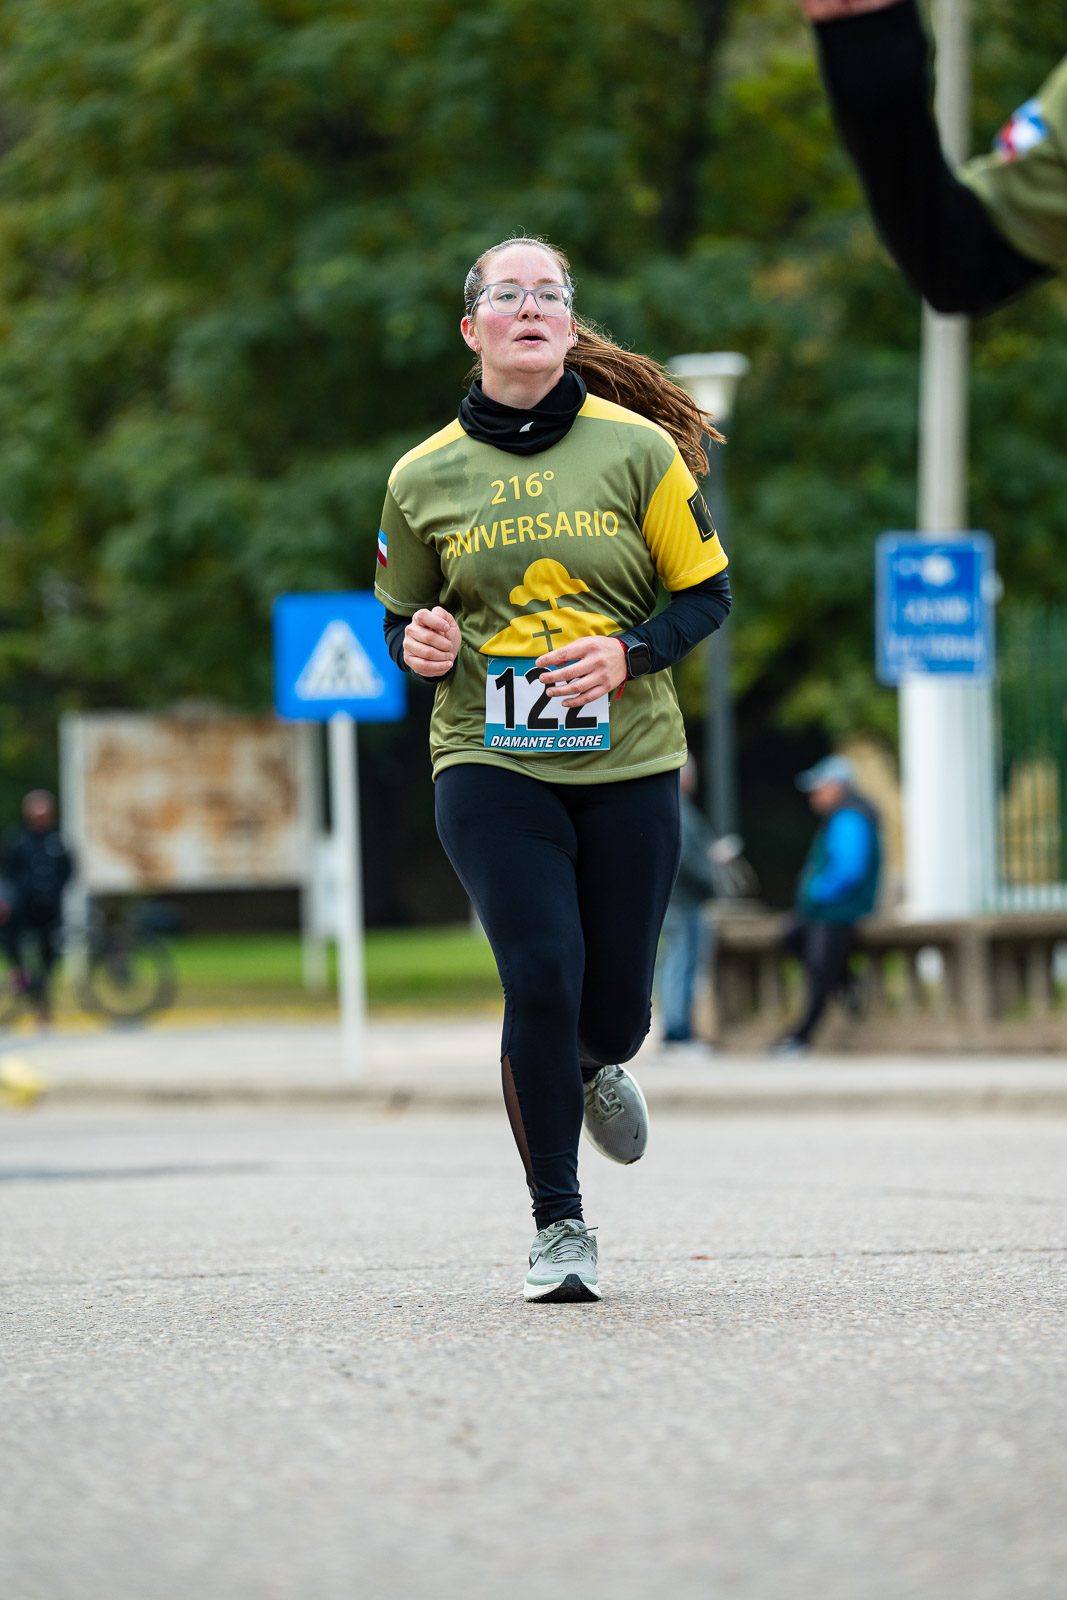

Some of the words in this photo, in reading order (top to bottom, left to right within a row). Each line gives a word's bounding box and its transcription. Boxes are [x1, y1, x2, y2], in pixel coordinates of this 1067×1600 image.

[445, 511, 619, 560] ANIVERSARIO
[490, 735, 555, 748] DIAMANTE
[557, 734, 603, 747] CORRE
